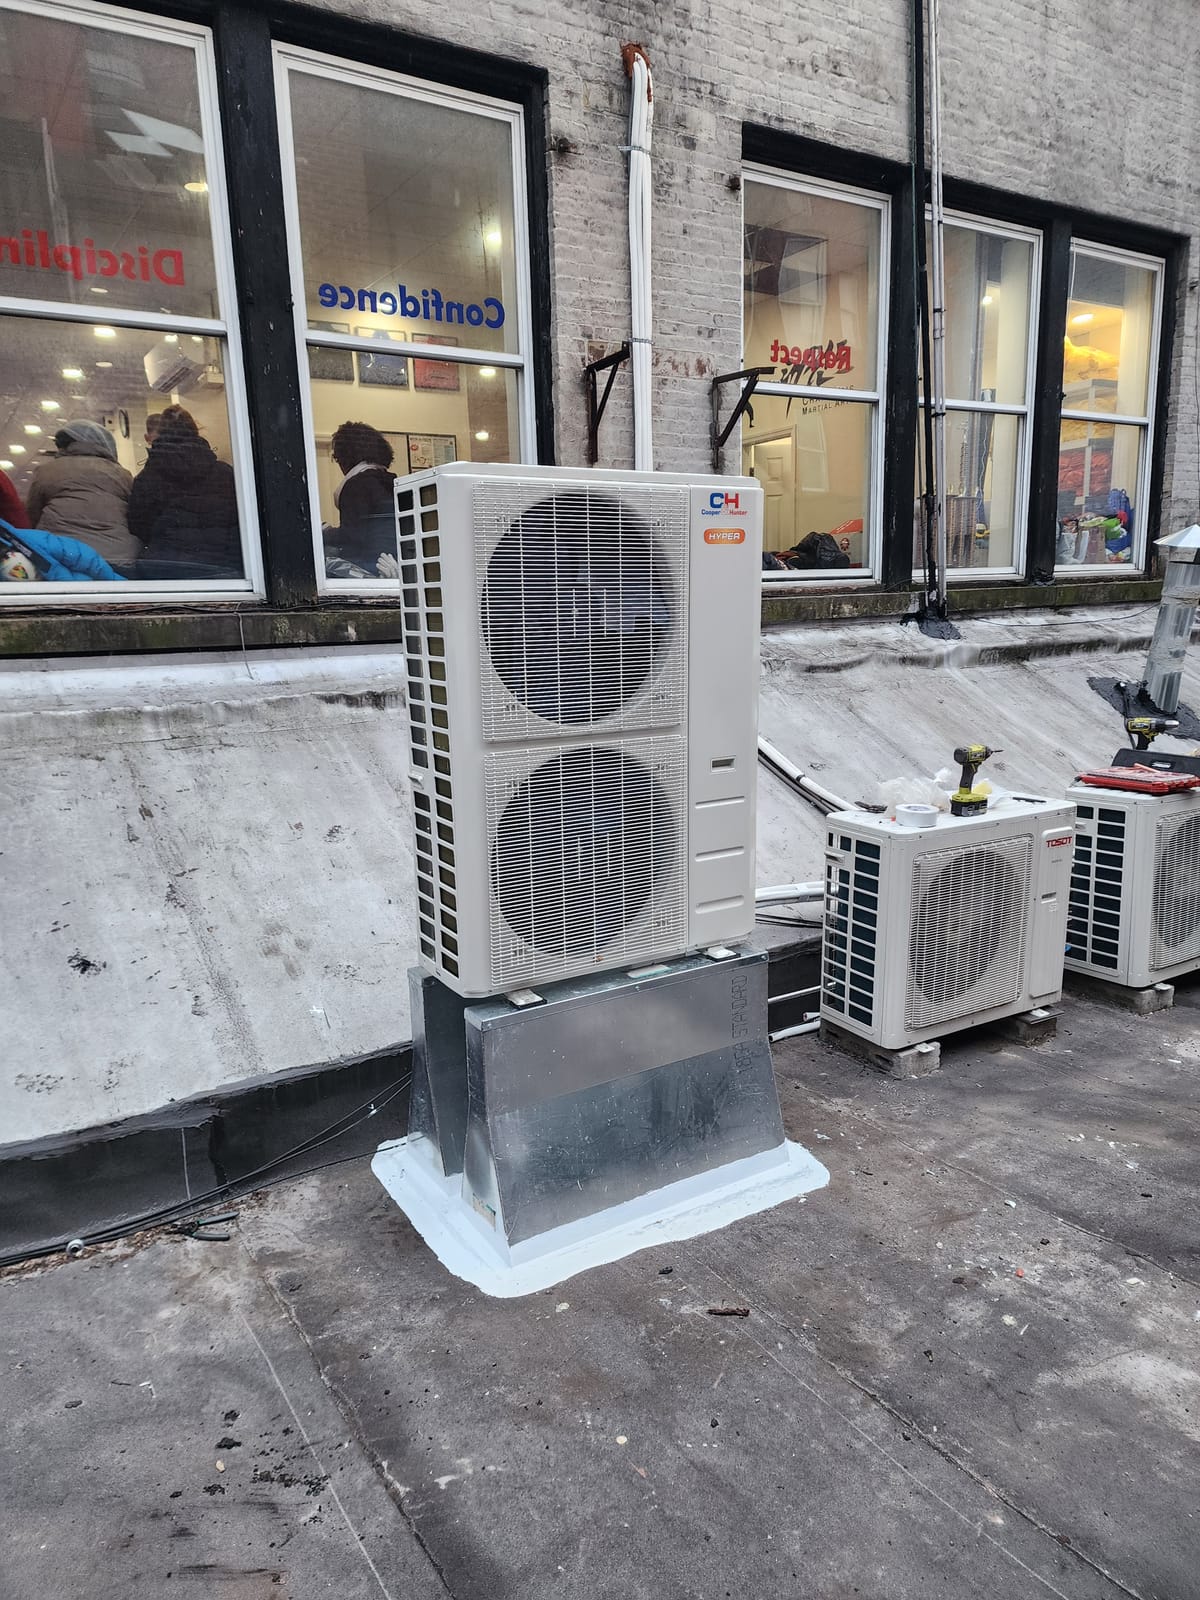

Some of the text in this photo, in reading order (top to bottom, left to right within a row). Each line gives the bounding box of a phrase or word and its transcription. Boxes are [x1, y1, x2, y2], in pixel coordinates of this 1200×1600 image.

[710, 492, 739, 509] CH
[709, 532, 740, 540] HYPER
[1046, 836, 1073, 848] TOSOT
[731, 974, 748, 1039] STANDARD
